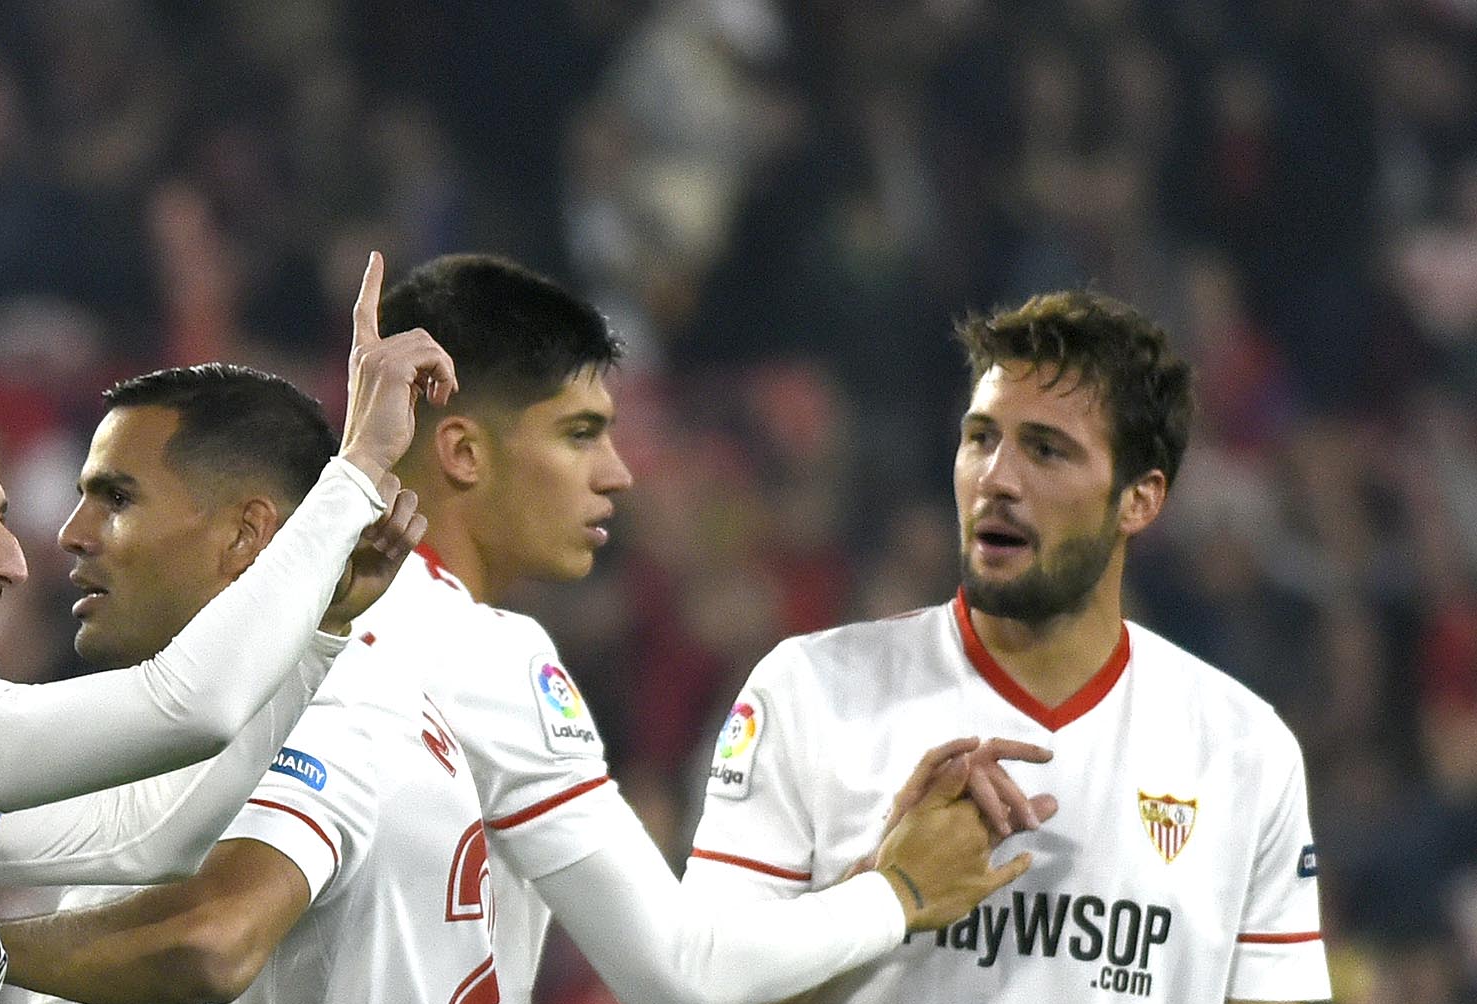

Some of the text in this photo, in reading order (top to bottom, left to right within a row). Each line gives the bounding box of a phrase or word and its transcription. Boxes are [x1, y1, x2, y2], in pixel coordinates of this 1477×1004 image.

[272, 752, 325, 785] IALITY
[903, 890, 1173, 968] ayWSOP
[1089, 966, 1153, 997] .com
